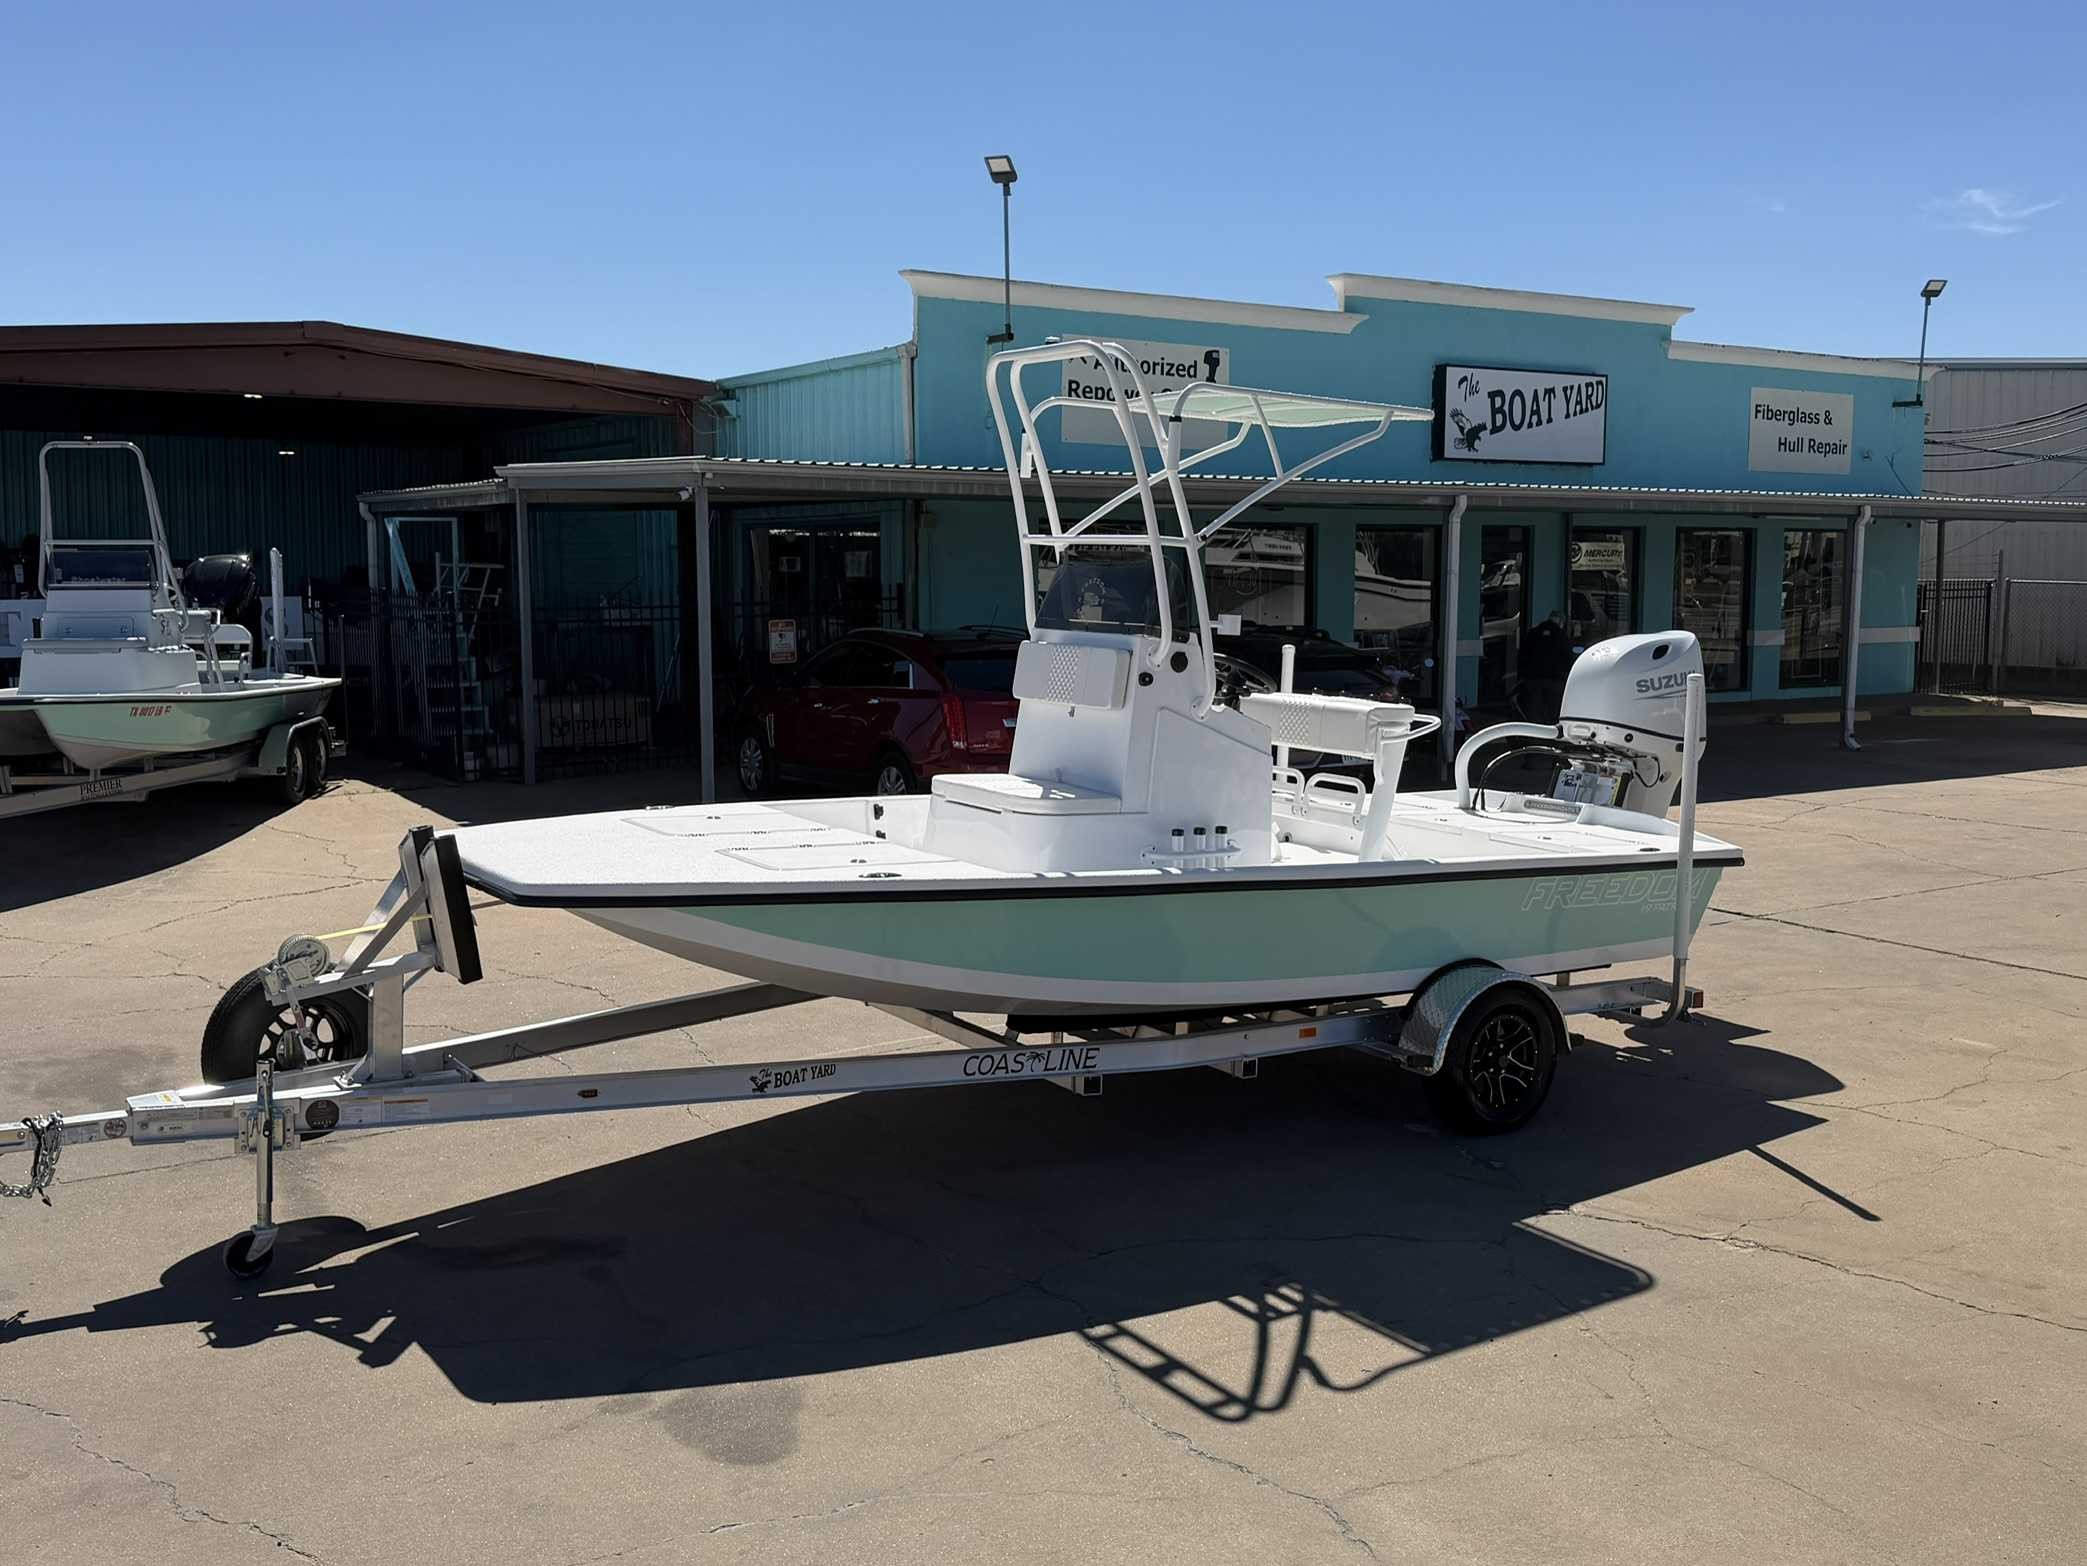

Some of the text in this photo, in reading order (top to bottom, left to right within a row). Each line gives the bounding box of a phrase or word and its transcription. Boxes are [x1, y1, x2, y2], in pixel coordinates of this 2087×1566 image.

[1458, 373, 1480, 402] The
[1487, 380, 1605, 435] BOAT YARD
[1754, 404, 1833, 426] Fiberglass &
[1778, 437, 1848, 458] Hull Repair
[773, 1063, 836, 1088] BOAT YARD
